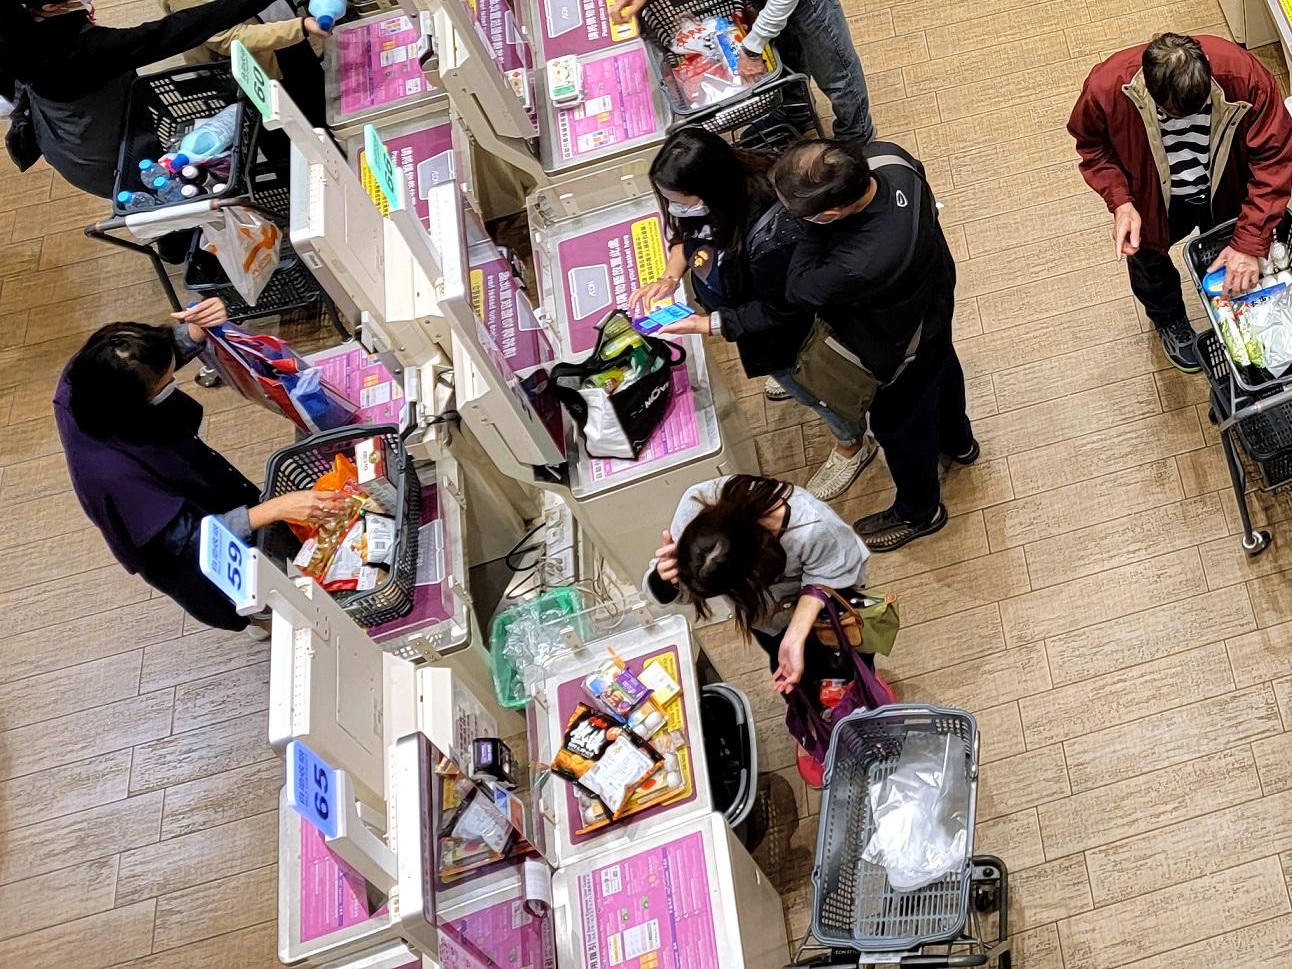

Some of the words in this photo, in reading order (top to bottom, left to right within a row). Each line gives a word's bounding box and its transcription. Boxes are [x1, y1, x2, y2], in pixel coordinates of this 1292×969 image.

[253, 66, 266, 103] 60
[384, 153, 394, 193] 66
[227, 541, 242, 591] 59
[314, 767, 329, 821] 65
